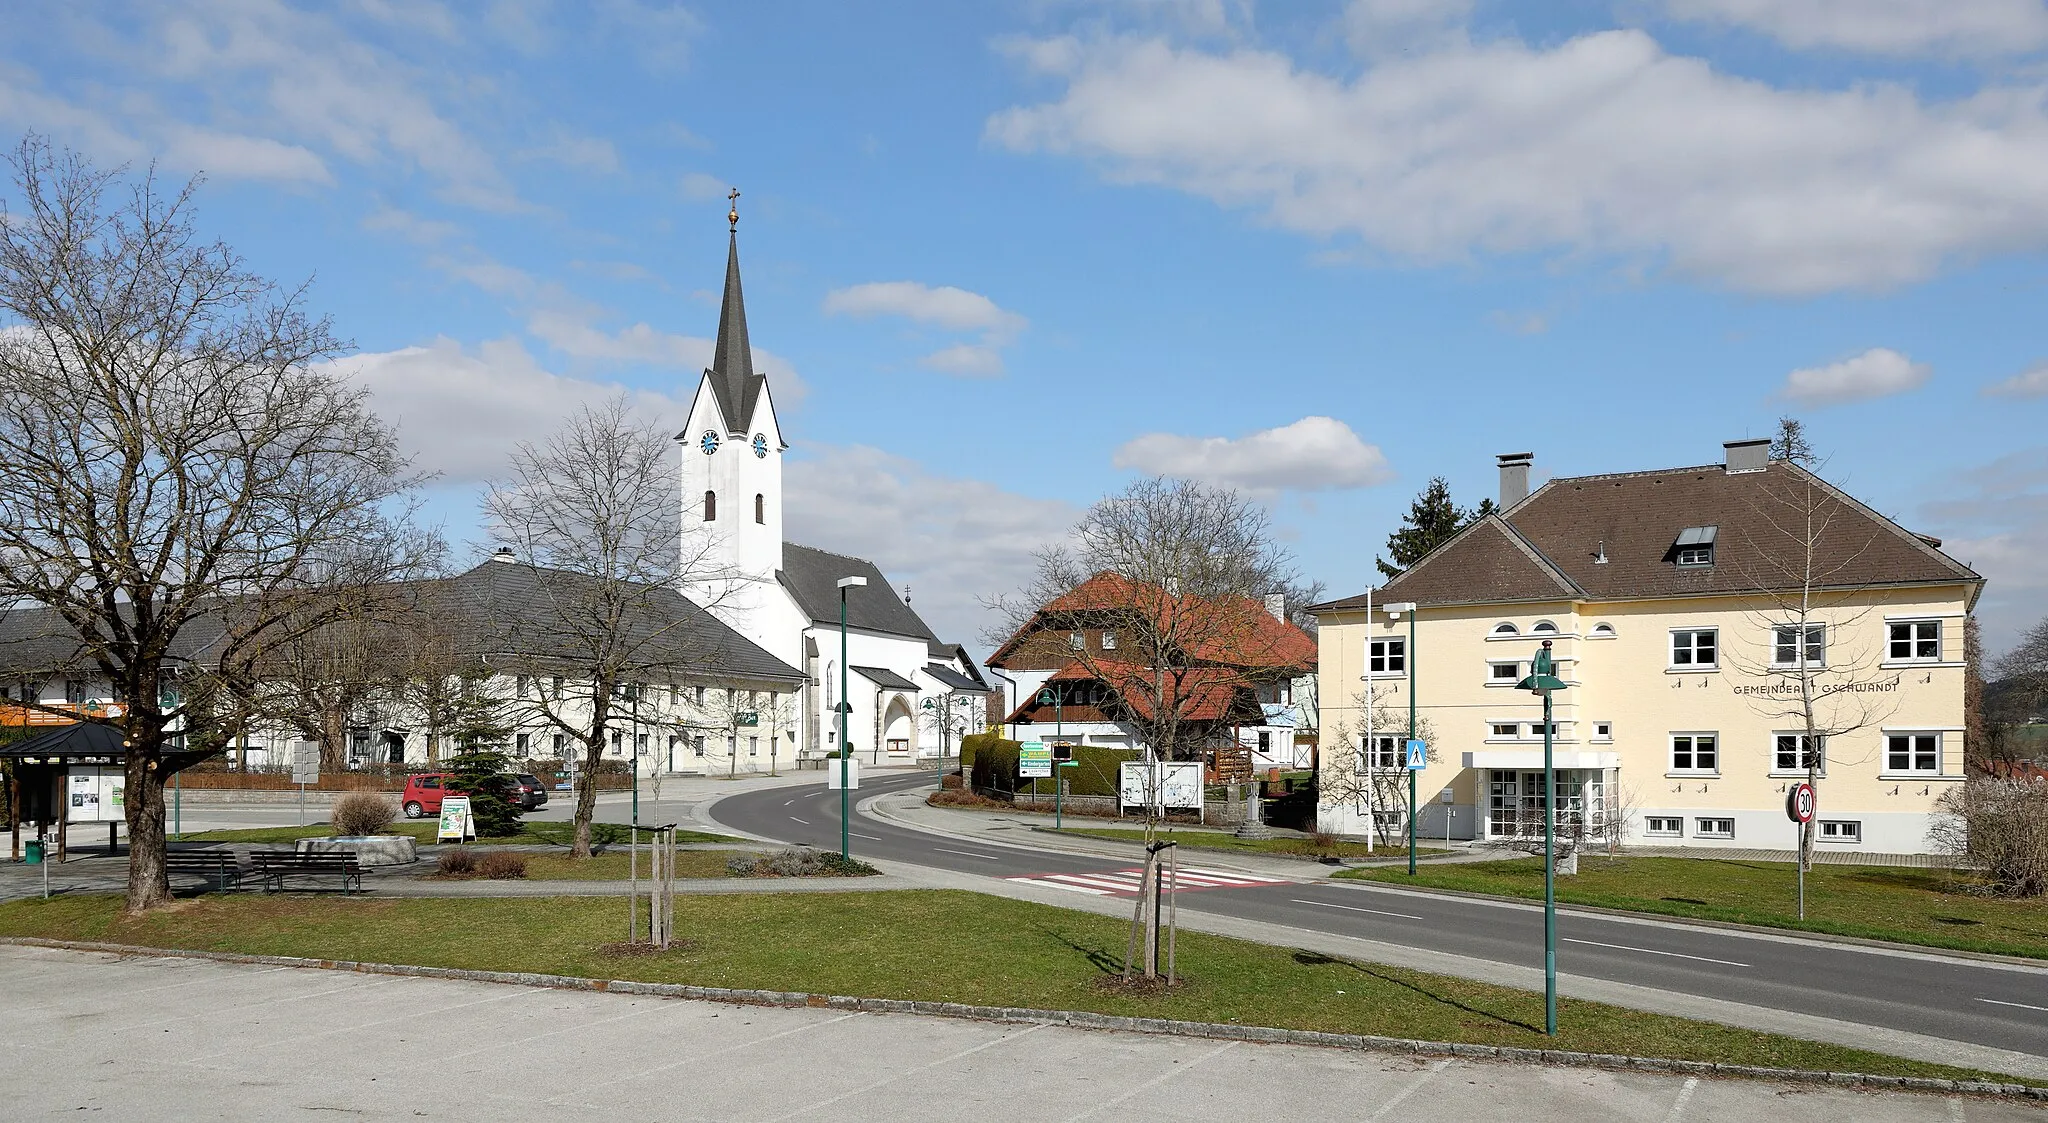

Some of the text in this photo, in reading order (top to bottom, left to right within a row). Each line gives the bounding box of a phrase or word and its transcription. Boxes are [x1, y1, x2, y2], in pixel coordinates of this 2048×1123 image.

[1734, 683, 1898, 694] GEMEINDEAT GSCHWANDT
[1801, 793, 1811, 814] 30
